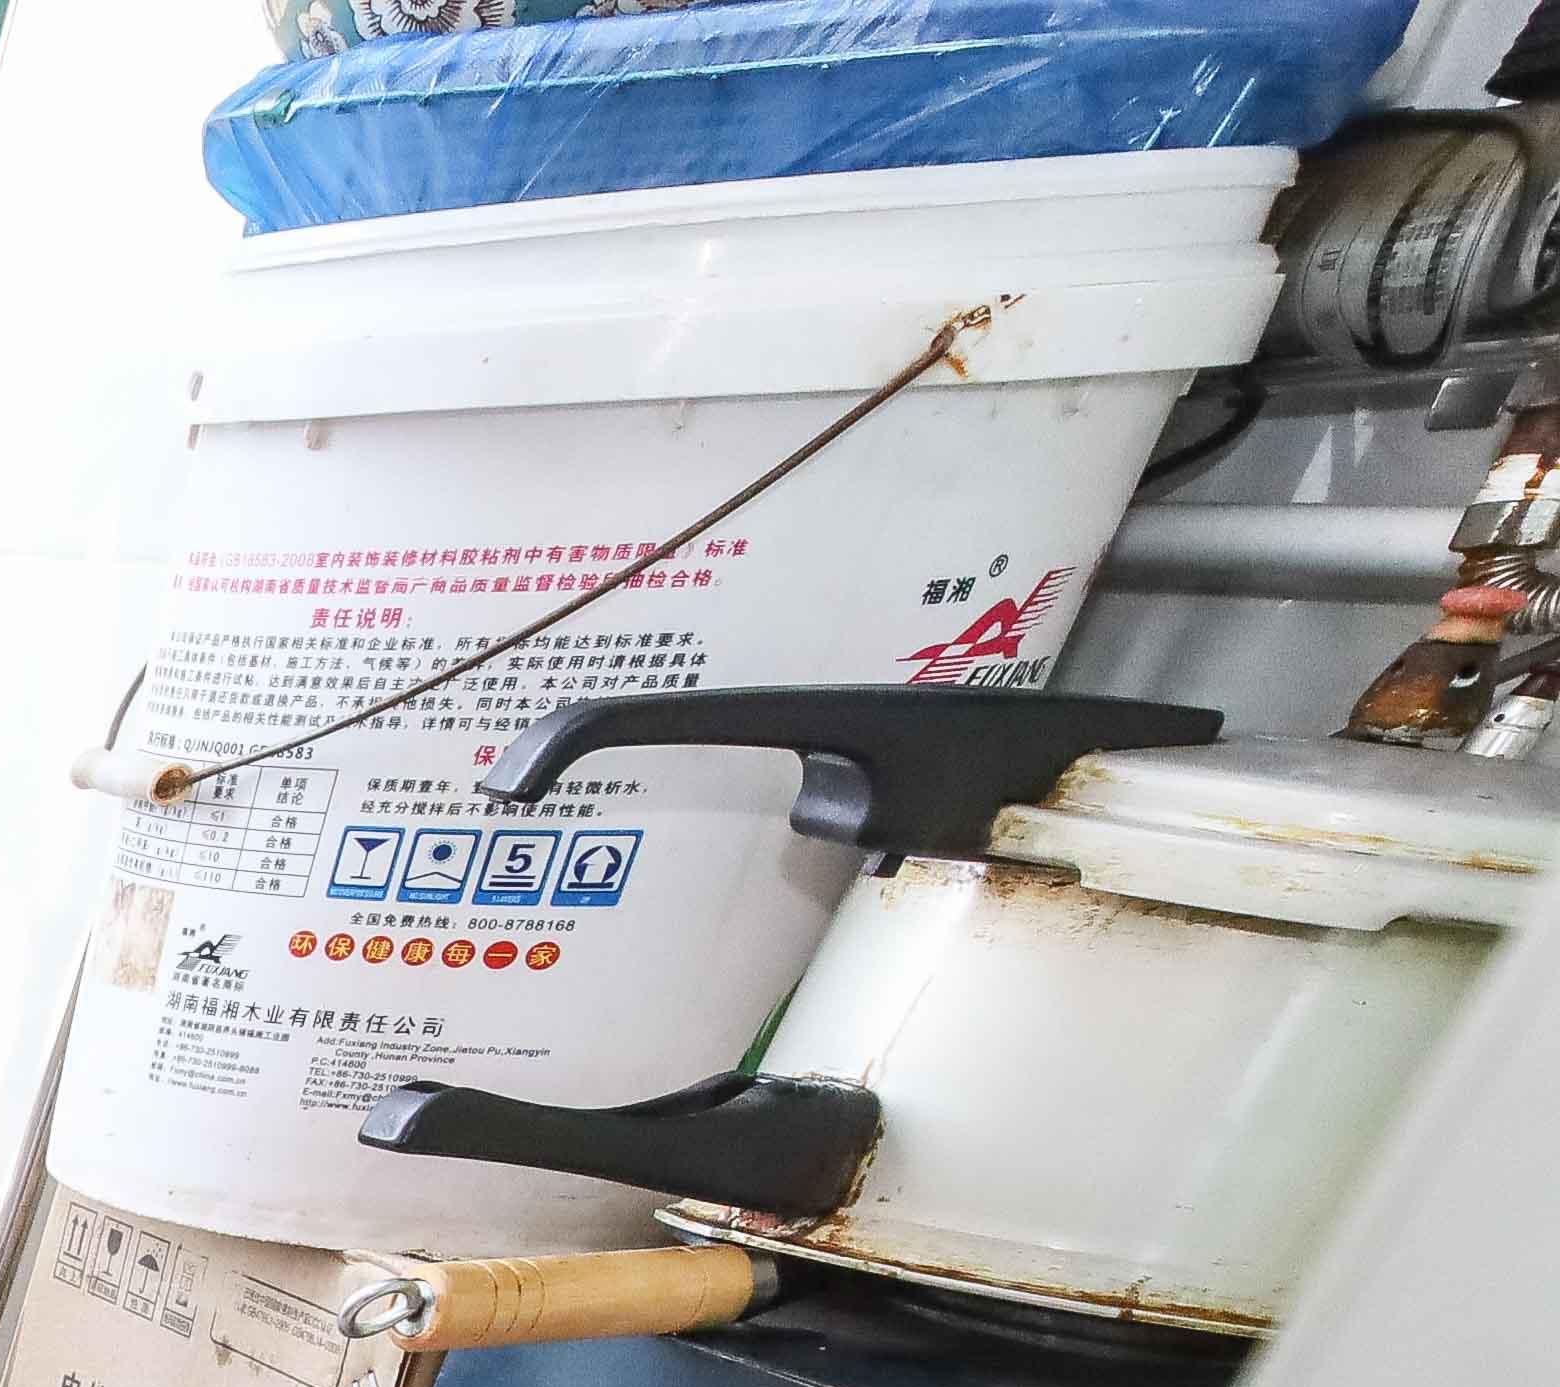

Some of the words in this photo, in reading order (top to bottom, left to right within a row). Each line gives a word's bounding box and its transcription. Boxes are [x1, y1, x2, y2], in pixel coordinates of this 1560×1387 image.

[922, 577, 976, 605] 福湘
[310, 607, 413, 629] 责任说明：
[280, 776, 308, 791] 单项
[277, 791, 304, 806] 结论
[271, 815, 299, 829] 合格
[265, 835, 293, 849] 合格
[260, 856, 287, 871] 合格
[505, 844, 535, 874] 5
[255, 877, 281, 891] 合格
[291, 933, 558, 968] 环保健康每一家
[166, 989, 445, 1038] 湖南福湘木业有限责任公司
[410, 1054, 455, 1064] Province
